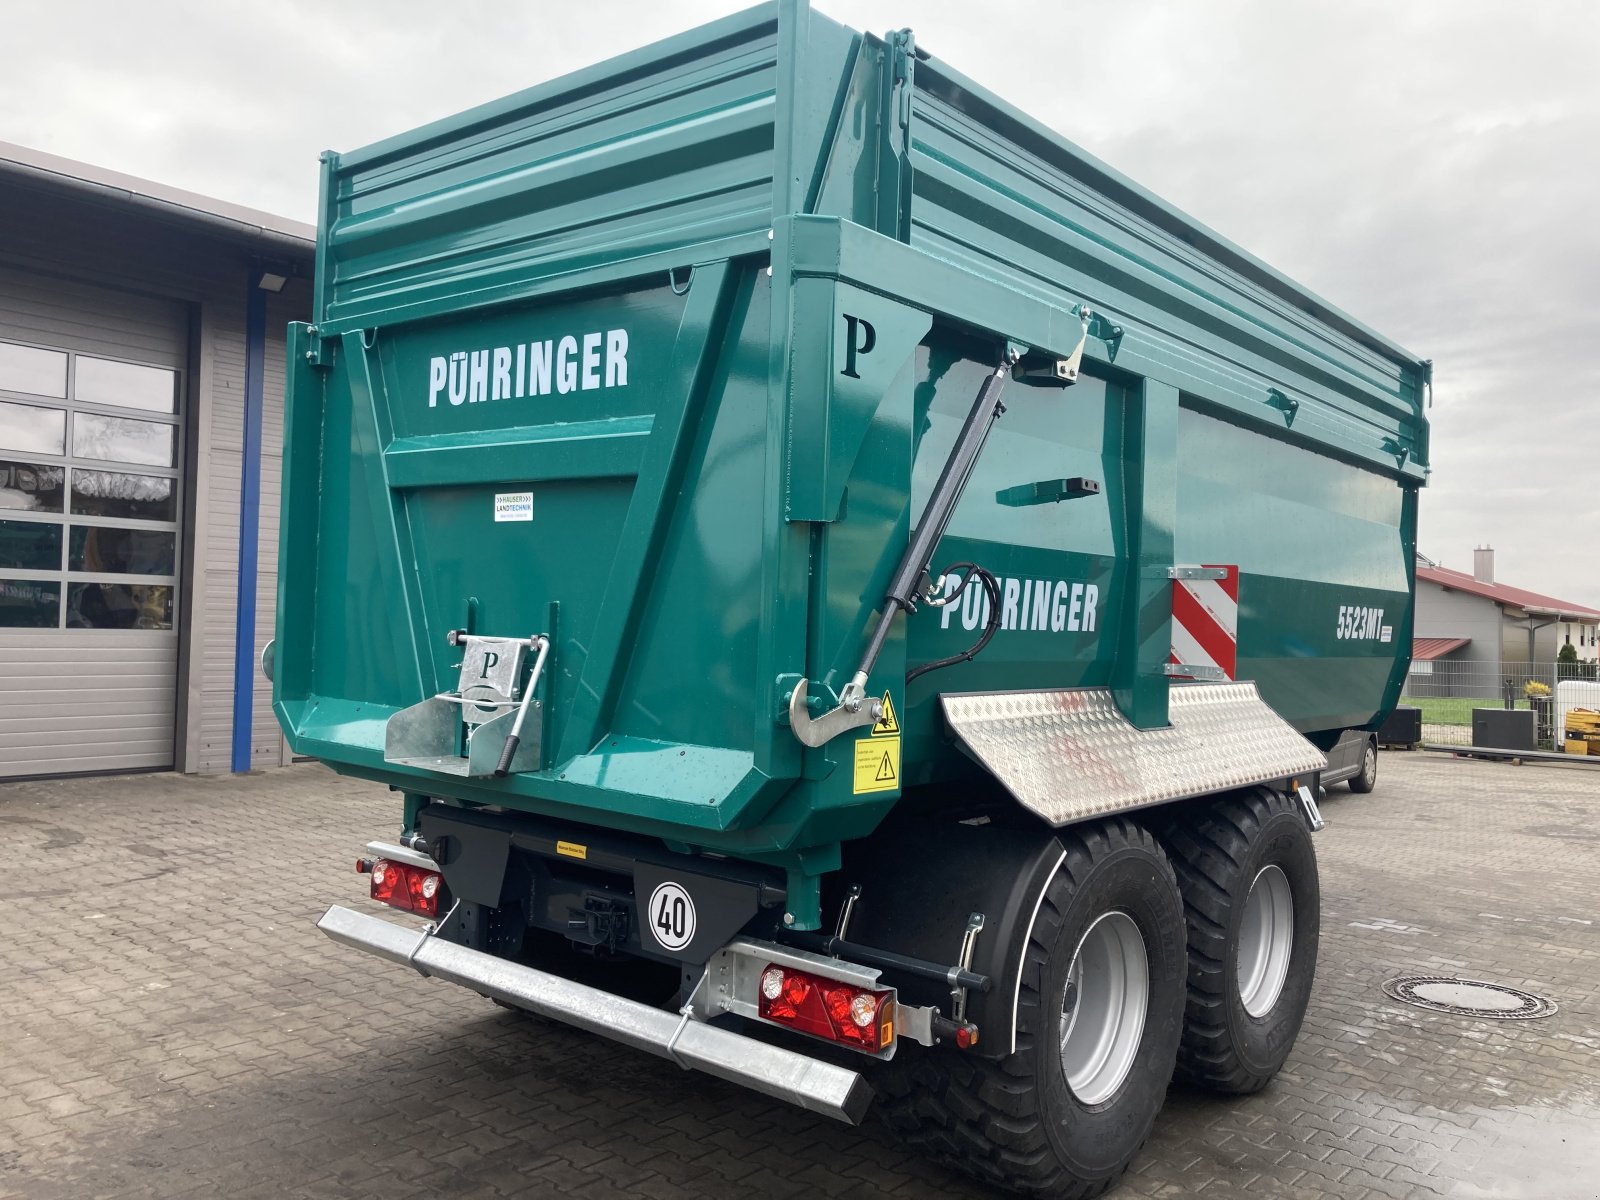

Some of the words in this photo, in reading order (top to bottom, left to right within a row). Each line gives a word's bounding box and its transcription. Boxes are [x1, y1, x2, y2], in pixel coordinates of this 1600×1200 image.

[841, 313, 876, 379] P
[429, 329, 629, 408] PÜHRINGER
[496, 504, 532, 512] LANDTECHNIK
[1336, 605, 1384, 640] 5523MT
[480, 652, 499, 679] P
[657, 893, 686, 939] 40
